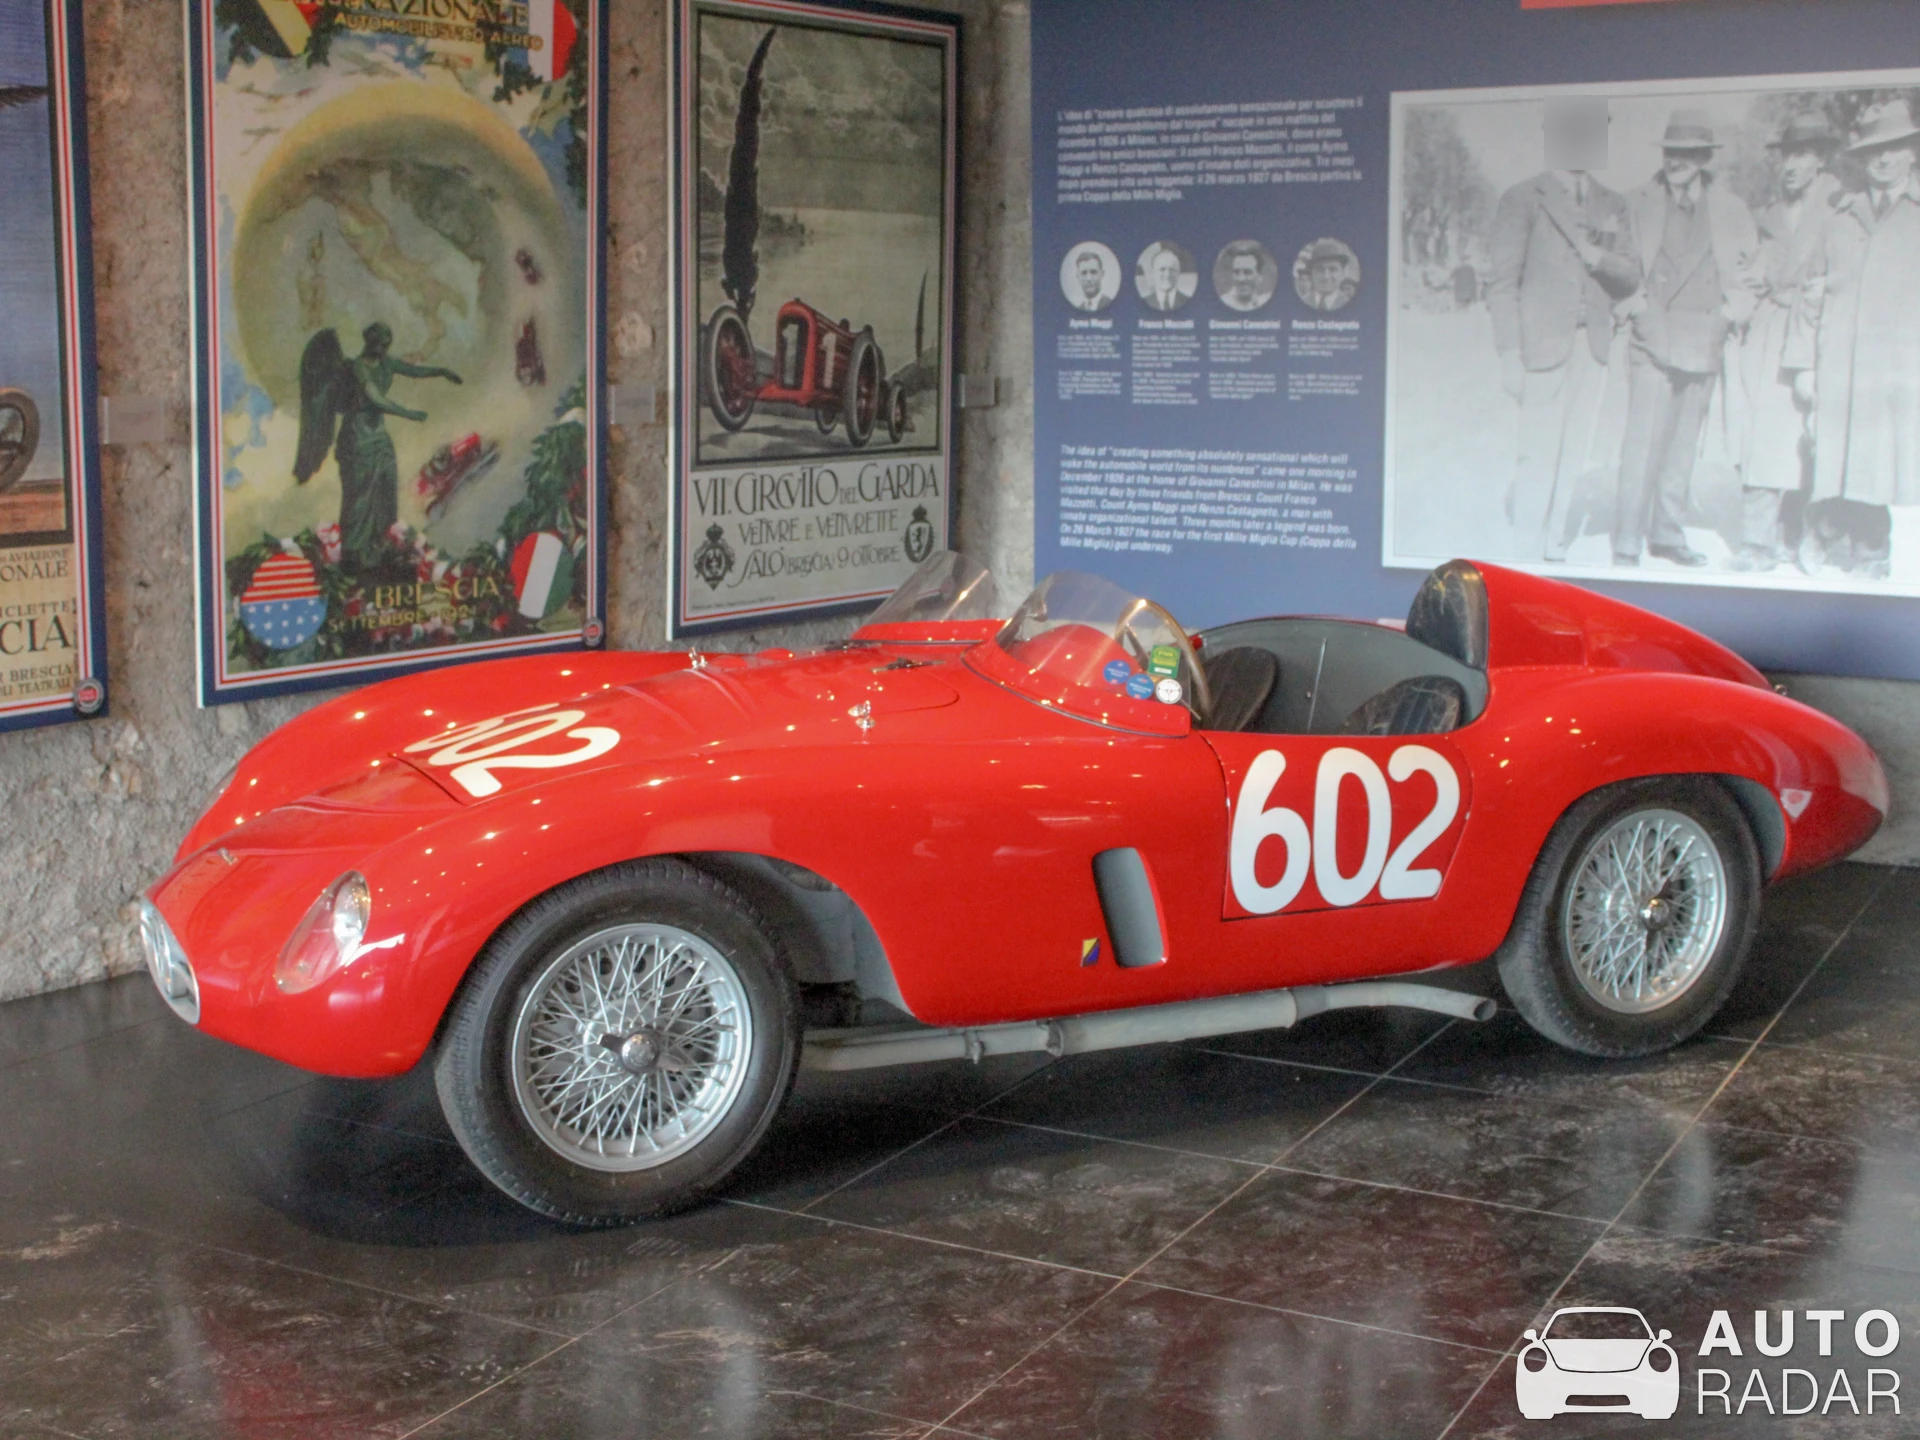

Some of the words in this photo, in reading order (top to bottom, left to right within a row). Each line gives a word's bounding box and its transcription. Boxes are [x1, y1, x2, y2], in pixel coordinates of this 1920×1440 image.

[1210, 319, 1241, 330] Giovanni
[1243, 319, 1280, 330] Canestrini
[1292, 319, 1316, 330] Renzo
[1318, 319, 1359, 331] Castagneto
[1077, 445, 1095, 457] idea
[1151, 448, 1196, 462] something
[1198, 449, 1243, 463] absolutely
[1246, 450, 1298, 463] sensational
[1301, 452, 1328, 463] which
[1331, 453, 1348, 464] will
[1099, 461, 1147, 472] automobile
[1149, 462, 1173, 473] world
[1175, 463, 1196, 474] from
[1262, 468, 1286, 476] came
[1289, 469, 1305, 477] one
[1308, 467, 1345, 480] morning
[859, 463, 940, 502] GARDA
[1060, 471, 1102, 484] December
[1105, 473, 1124, 484] 1926
[1136, 474, 1150, 485] the
[1153, 475, 1175, 486] home
[1189, 476, 1226, 488] Giovanni
[1229, 478, 1275, 490] Canestrini
[1334, 484, 1352, 493] was
[1090, 486, 1108, 497] that
[1109, 487, 1124, 499] day
[1138, 488, 1160, 499] three
[1162, 489, 1193, 500] friends
[1196, 490, 1216, 501] from
[1256, 492, 1282, 503] Count
[1284, 493, 1316, 505] Franco
[1101, 500, 1125, 511] Count
[1127, 501, 1150, 514] Aymo
[1152, 502, 1178, 515] Maggi
[1180, 503, 1197, 514] and
[1199, 504, 1224, 515] Renzo
[1291, 510, 1310, 519] man
[1313, 509, 1332, 520] with
[805, 524, 813, 540] E
[1088, 512, 1149, 527] organizational
[1183, 516, 1207, 528] Three
[1209, 518, 1240, 529] months
[1243, 519, 1264, 531] later
[1274, 521, 1305, 534] legend
[1307, 524, 1324, 533] was
[1060, 537, 1081, 547] Mille
[1085, 525, 1111, 537] March
[1114, 527, 1134, 538] 1927
[1151, 530, 1170, 539] race
[1187, 530, 1201, 541] the
[1203, 531, 1222, 542] first
[1224, 532, 1247, 543] Mille
[1250, 533, 1277, 547] Miglia
[1280, 535, 1297, 548] Cup
[1333, 537, 1356, 549] della
[9, 548, 70, 562] AVIAZIONE
[838, 547, 849, 569] 9
[852, 545, 900, 568] OTTOBRE
[10, 663, 72, 682] BRESCIA
[403, 702, 621, 798] 602
[1230, 744, 1460, 915] 602
